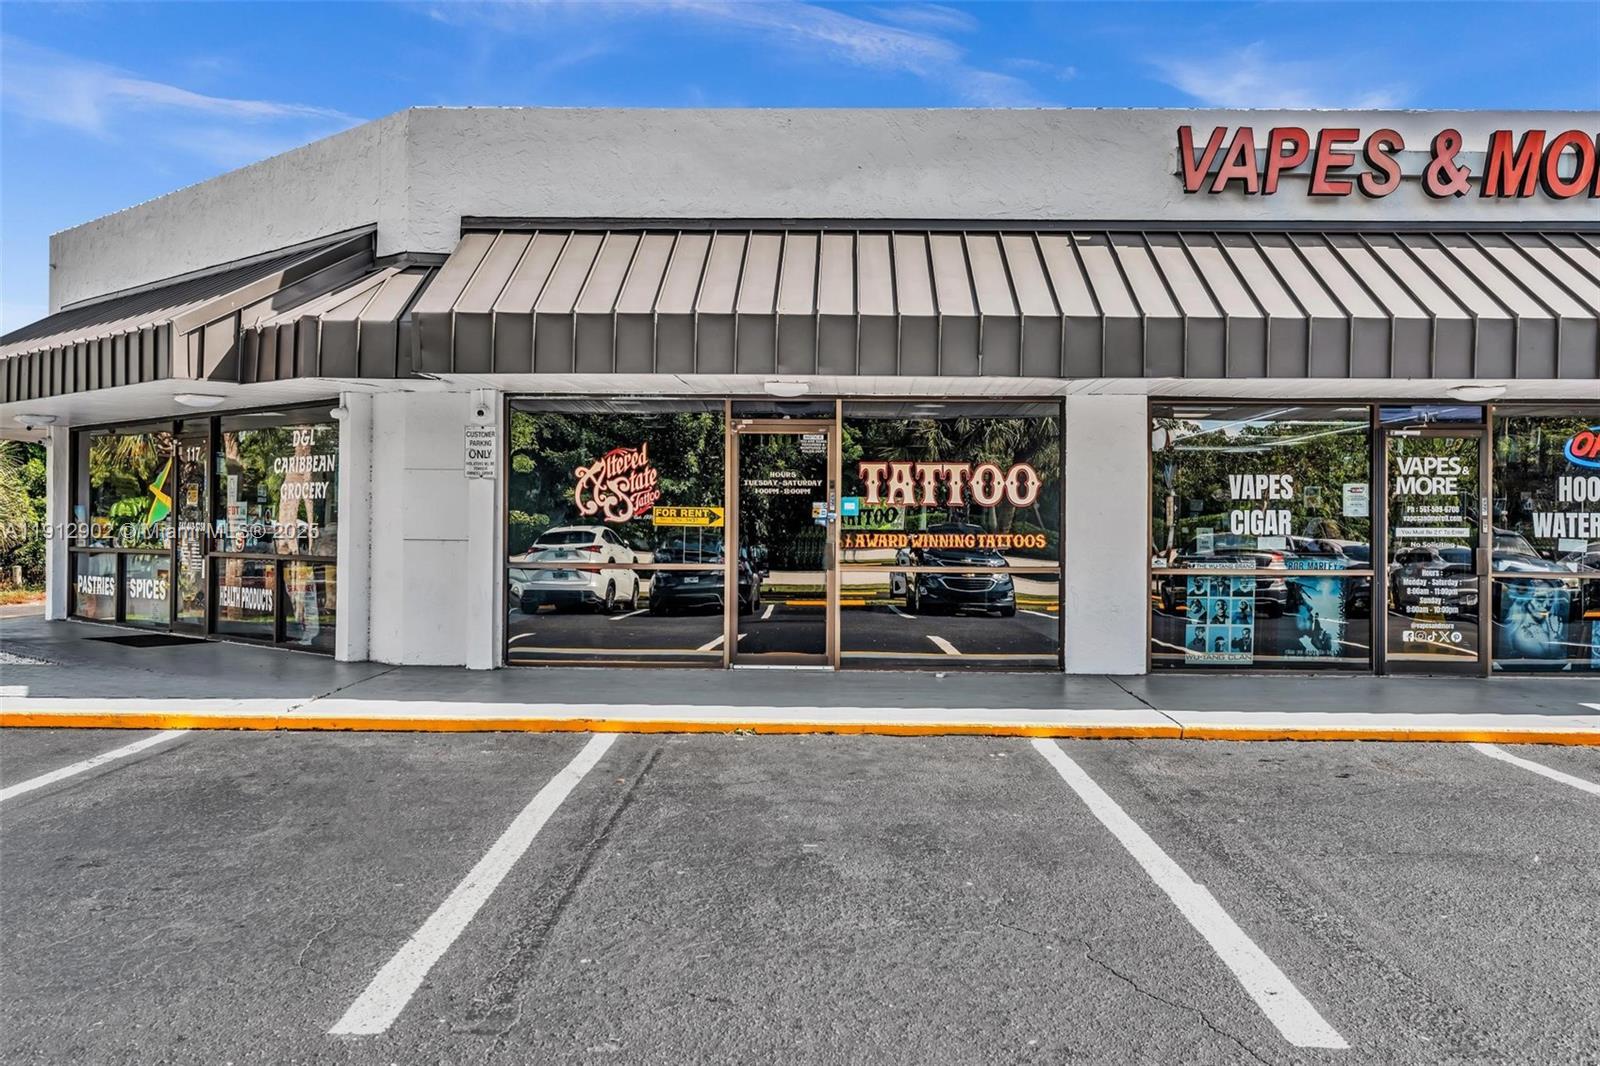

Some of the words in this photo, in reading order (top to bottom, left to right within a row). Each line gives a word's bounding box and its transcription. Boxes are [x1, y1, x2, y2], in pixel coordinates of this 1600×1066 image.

[1177, 125, 1405, 198] VAPES
[1422, 128, 1472, 199] &
[1480, 130, 1600, 200] MO
[292, 429, 315, 447] D&L
[466, 430, 496, 438] CUSTOMER
[187, 446, 201, 462] 117
[274, 454, 337, 474] CARIBBEAN
[468, 449, 493, 459] ONLY
[1396, 456, 1461, 475] VAPES
[1462, 465, 1470, 475] &
[574, 441, 649, 517] Altered
[743, 479, 778, 487] TUESDAY
[782, 479, 823, 487] SATURDAY
[858, 461, 1042, 508] TATTOO
[1229, 473, 1294, 499] VAPES
[1396, 476, 1458, 495] MORE
[280, 481, 330, 501] GROCERY
[603, 465, 658, 523] State
[630, 487, 661, 511] Tattoo
[655, 508, 677, 518] FOR
[680, 508, 709, 518] RENT
[1230, 509, 1292, 537] CIGAR
[1532, 511, 1600, 538] WATER
[855, 533, 908, 548] AWARD
[911, 533, 976, 548] WINNING
[977, 533, 1046, 548] TATTOOS
[78, 575, 115, 596] PASTRIES
[130, 578, 167, 601] SPICES
[1431, 578, 1458, 587] Saturday
[219, 585, 241, 608] HEALTH
[241, 587, 273, 612] PRODUCTS
[1419, 597, 1442, 605] Sunday
